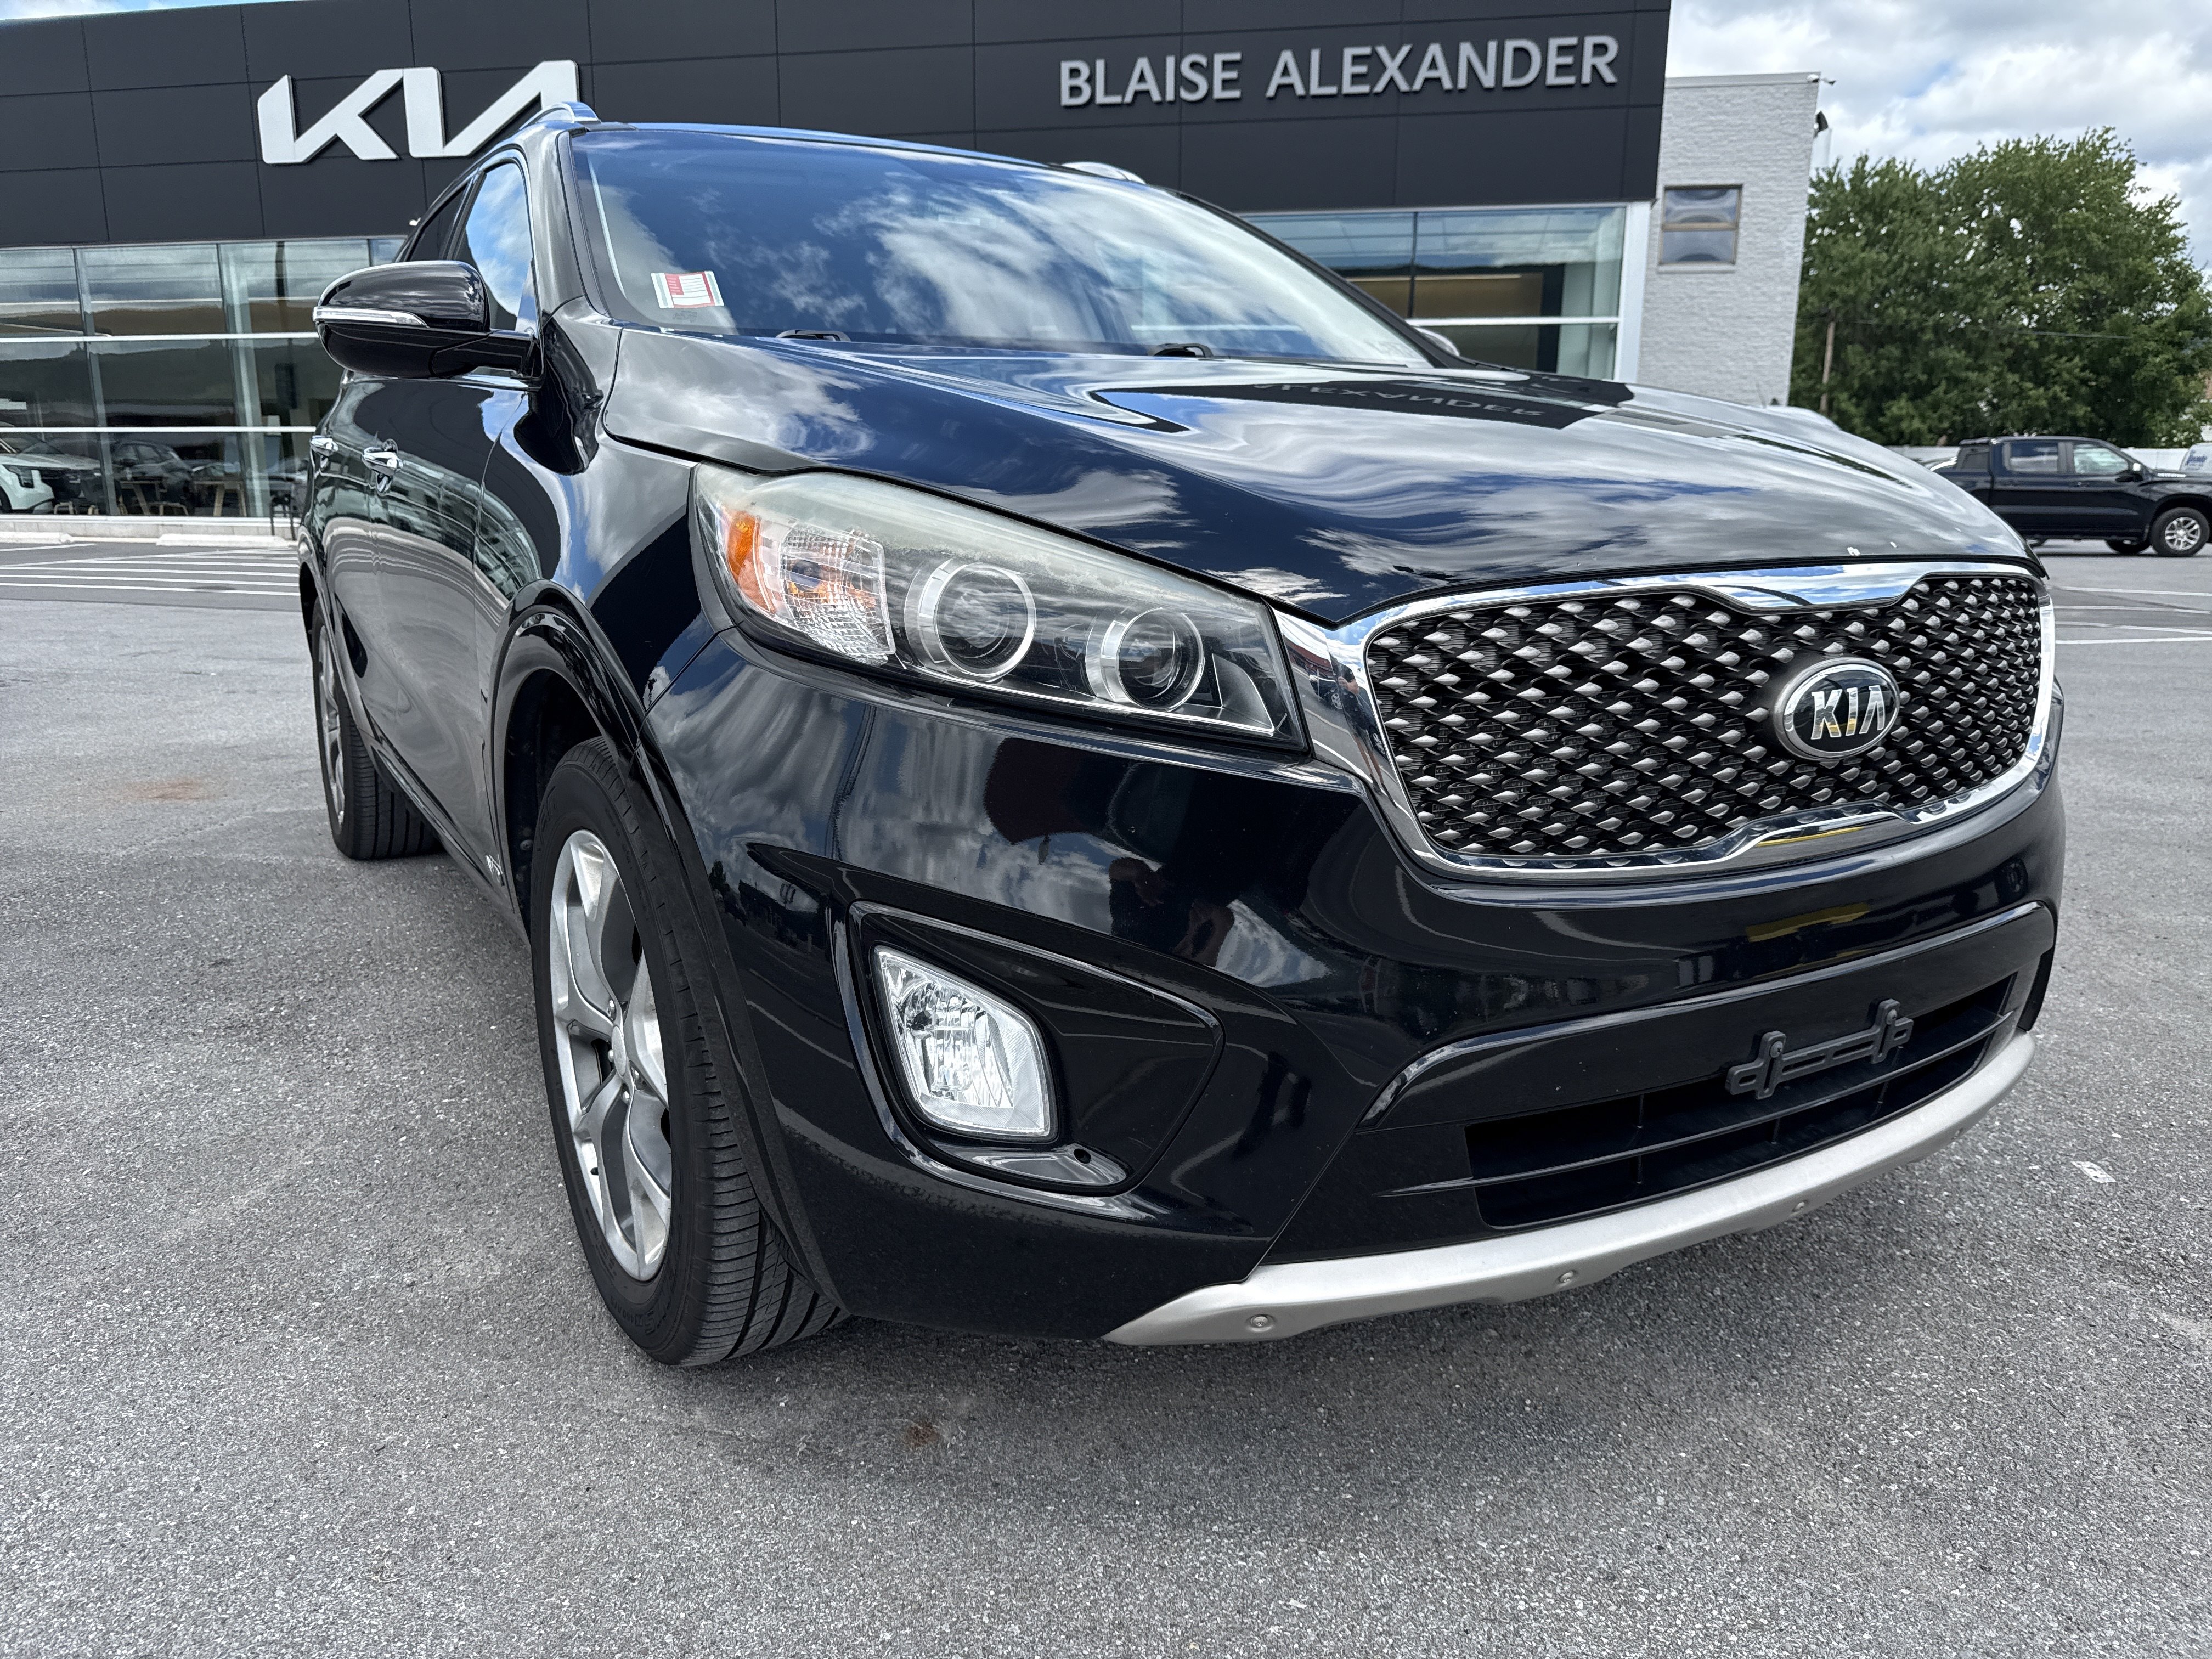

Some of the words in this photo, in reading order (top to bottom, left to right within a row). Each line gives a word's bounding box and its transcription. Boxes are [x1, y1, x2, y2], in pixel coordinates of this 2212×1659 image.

[1060, 51, 1242, 107] BLAISE
[1265, 35, 1620, 98] ALEXANDER
[1810, 685, 1886, 740] KIA
